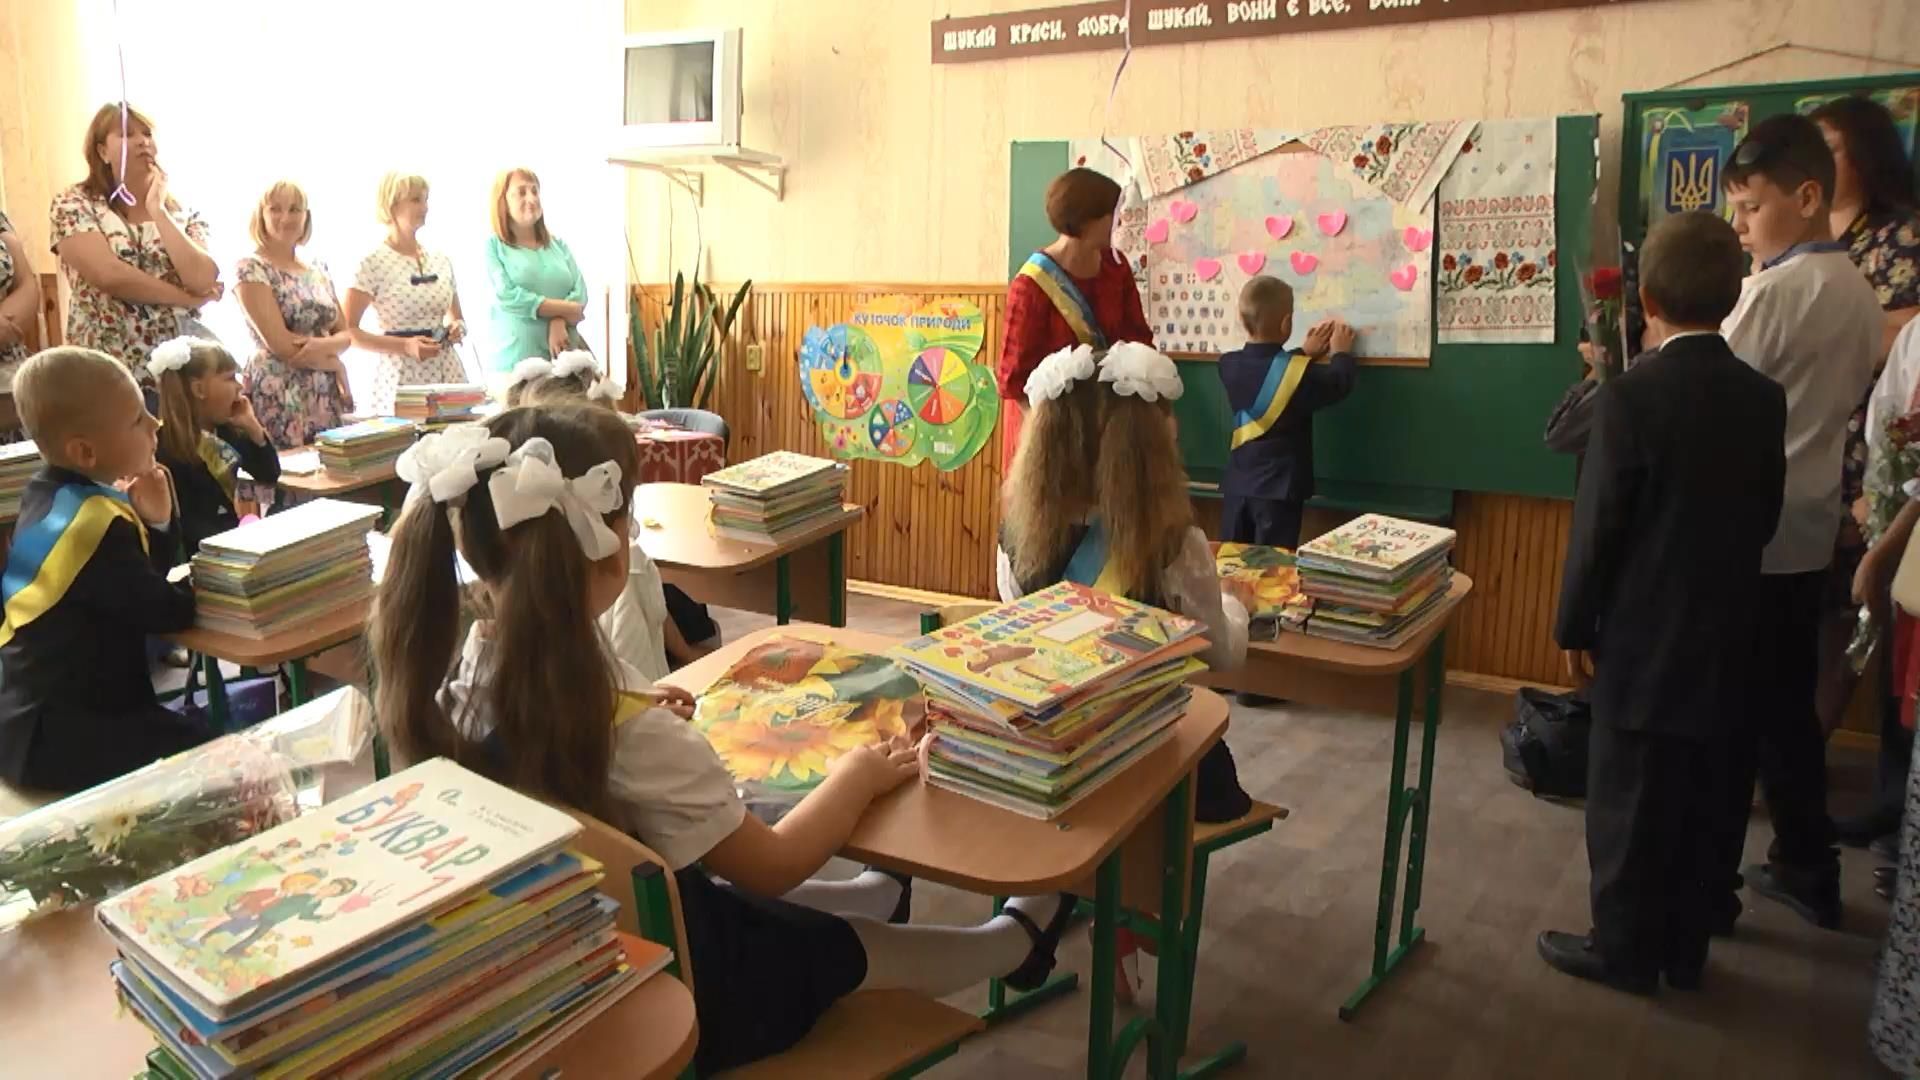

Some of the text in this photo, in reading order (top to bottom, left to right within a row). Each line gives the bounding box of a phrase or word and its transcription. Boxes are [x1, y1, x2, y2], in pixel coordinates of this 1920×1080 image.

[943, 25, 996, 50] ШУКАЙ
[1010, 19, 1066, 45] КРАСИ,
[1077, 14, 1129, 37] ДОБРА
[1147, 4, 1213, 30] ШУКАЙ,
[1227, 0, 1277, 24] ВОНИ
[854, 311, 971, 331] КУТОЧОК ПРИРОДИ
[336, 783, 490, 874] БУКВАР
[397, 874, 455, 906] 1
